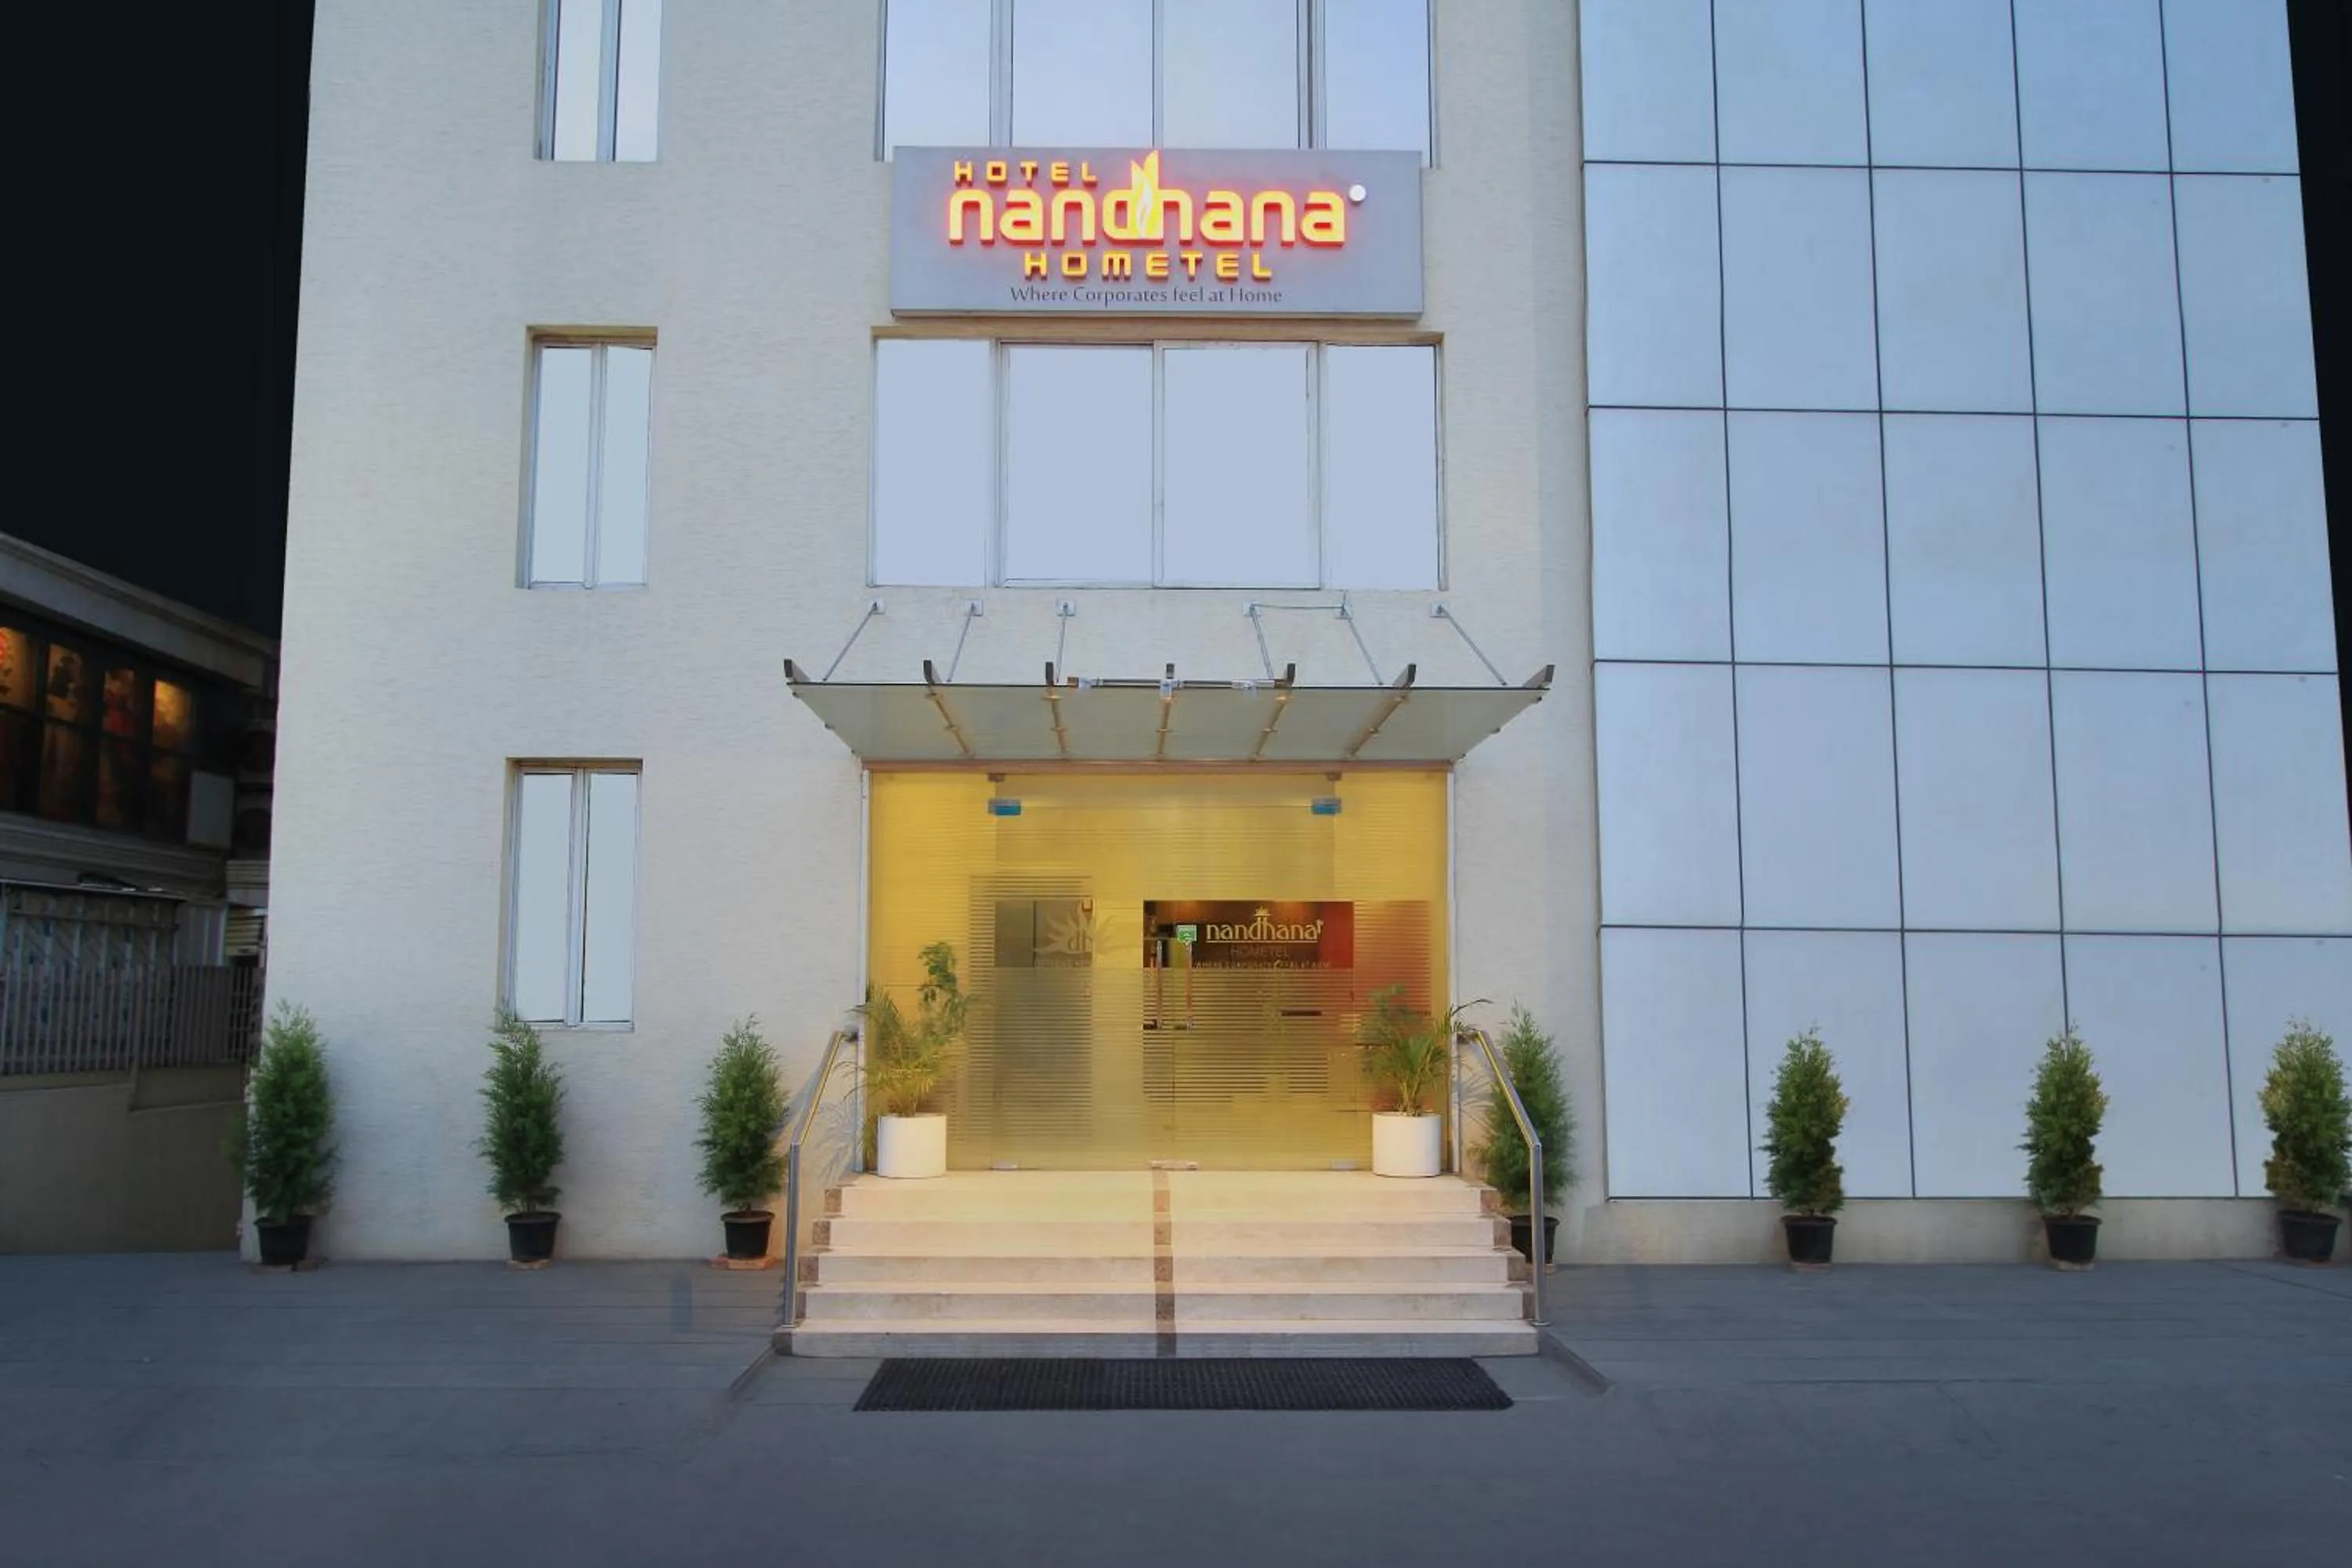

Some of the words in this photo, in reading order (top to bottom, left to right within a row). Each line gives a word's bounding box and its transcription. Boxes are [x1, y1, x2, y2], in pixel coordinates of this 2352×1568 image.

[953, 160, 1098, 185] HOTEL
[948, 150, 1347, 245] nandhana
[1023, 250, 1273, 281] HOMETEL
[1010, 286, 1068, 302] Where
[1073, 286, 1167, 307] Corporates
[1208, 289, 1225, 302] at
[1229, 287, 1283, 303] Home
[1206, 916, 1318, 940] nandhana
